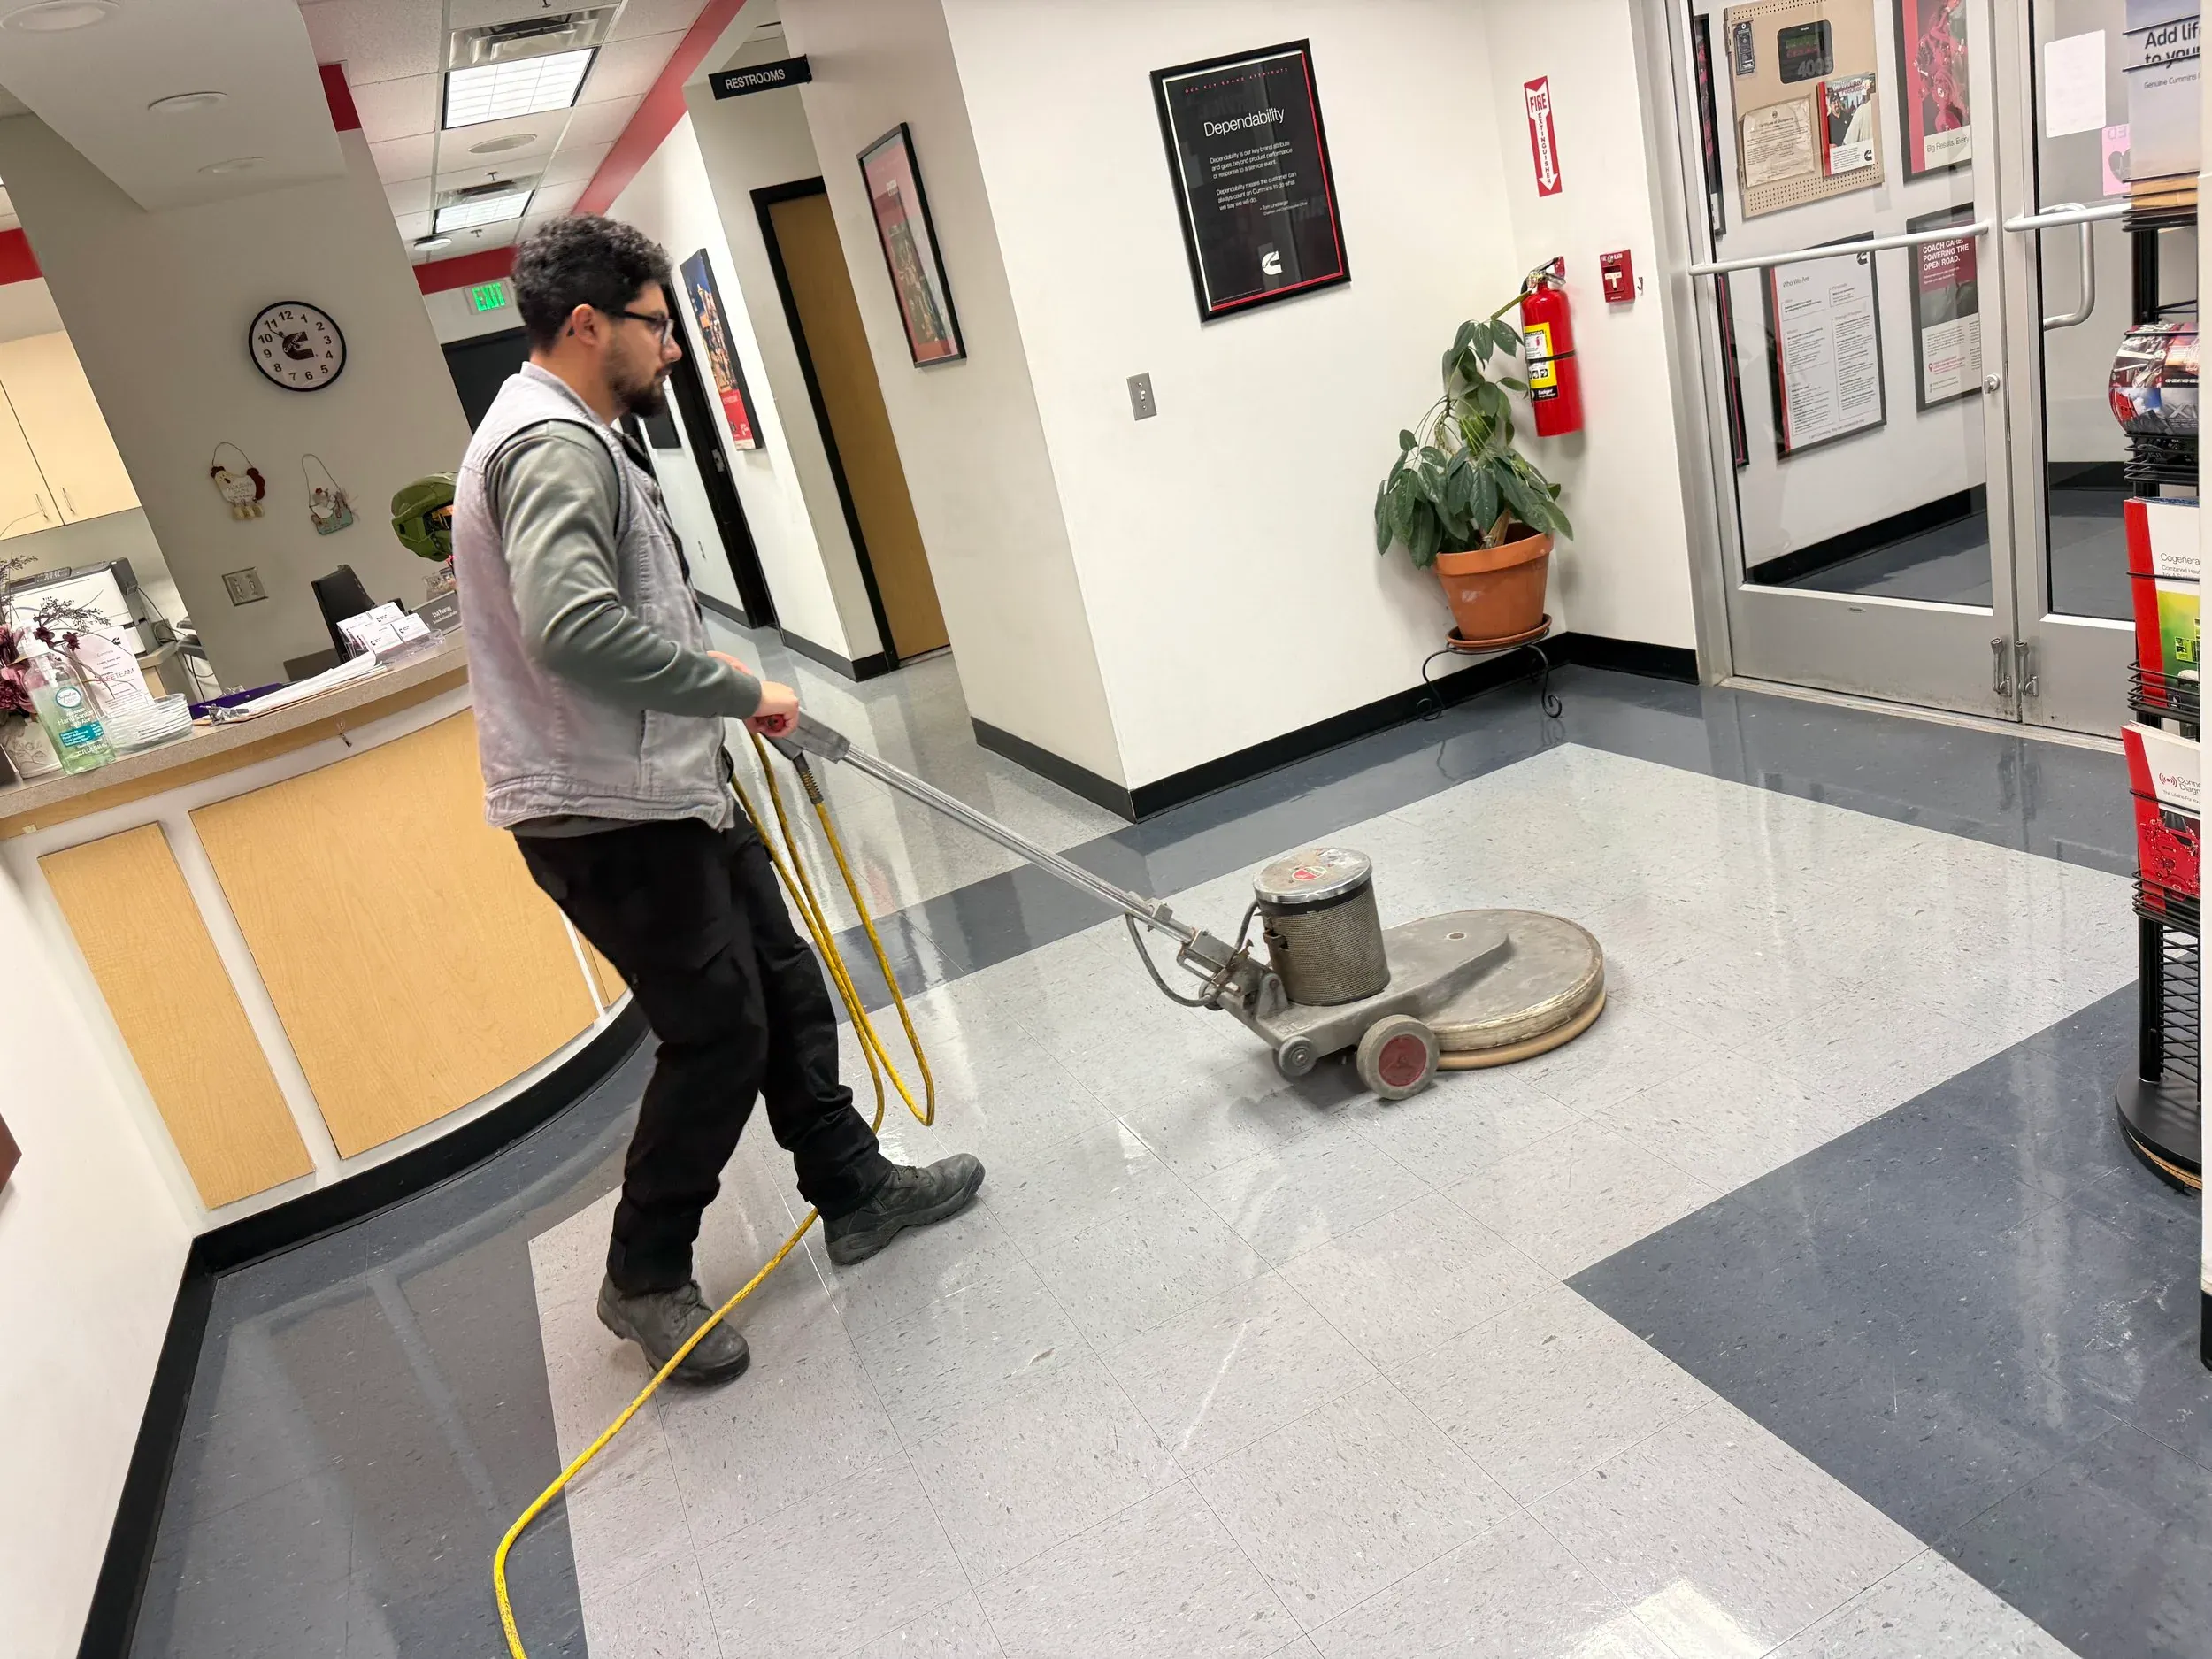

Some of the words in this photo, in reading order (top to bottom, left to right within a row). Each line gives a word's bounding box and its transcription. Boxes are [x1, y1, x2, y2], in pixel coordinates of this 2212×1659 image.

[2145, 27, 2177, 50] Add
[2182, 21, 2200, 41] lif
[1249, 67, 1288, 79] ATTRIBUTE
[725, 69, 786, 90] RESTROOMS
[2145, 80, 2167, 89] Genuine
[2169, 73, 2196, 84] Cummins
[1530, 93, 1547, 113] FIRE
[1203, 108, 1285, 136] Dependability
[1538, 112, 1552, 184] EXTINGUISHER
[1210, 152, 1239, 164] Dependability
[1217, 184, 1245, 195] Dependability
[1923, 242, 1945, 254] COACH
[1924, 248, 1955, 263] POWERING
[1956, 243, 1969, 253] THE
[1924, 260, 1940, 271] OPEN
[1941, 255, 1961, 266] ROAD.
[472, 282, 505, 311] EXIT
[279, 311, 294, 320] 12
[301, 314, 308, 323] 1
[265, 319, 278, 329] 11
[316, 322, 325, 331] 2
[258, 334, 273, 344] 10
[324, 335, 332, 344] 3
[264, 349, 272, 358] 9
[326, 350, 333, 359] 4
[273, 363, 282, 372] 8
[320, 365, 328, 373] 5
[2161, 553, 2200, 565] Cogenera
[2177, 777, 2200, 788] Conne
[2179, 783, 2200, 795] Diagn
